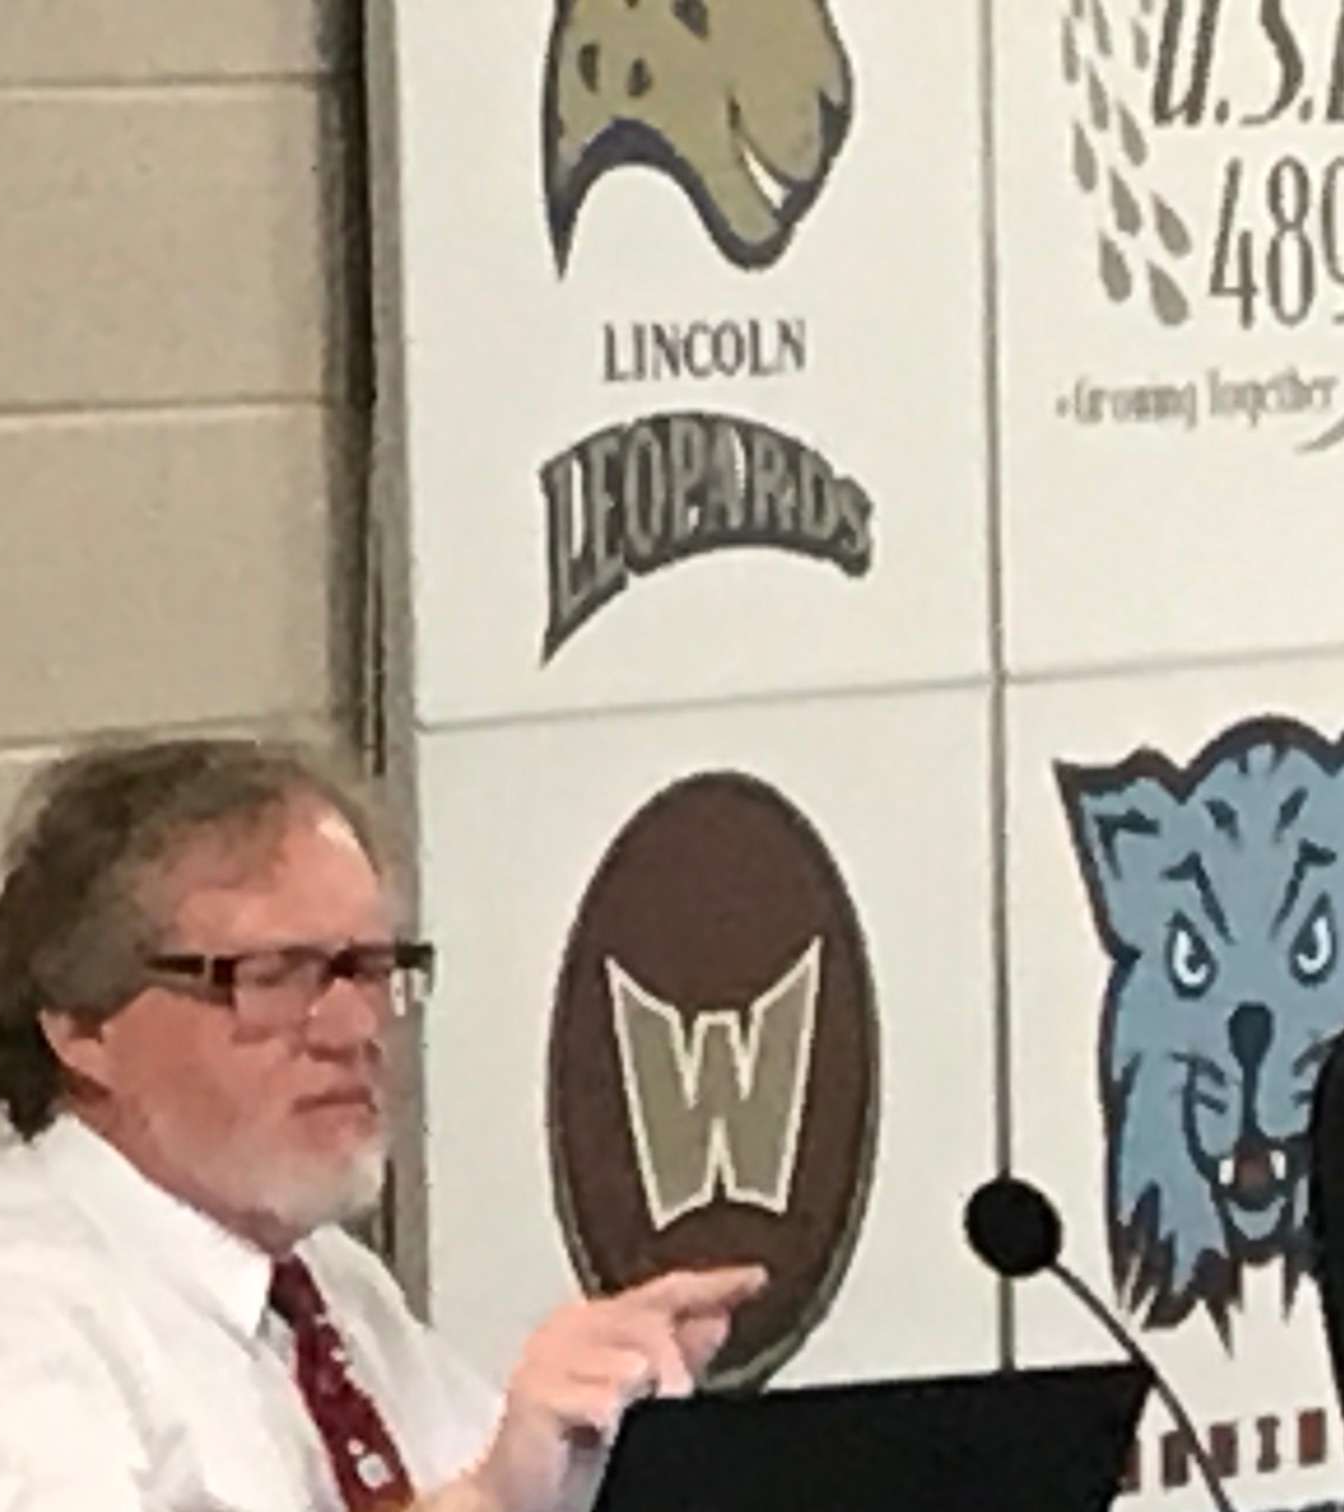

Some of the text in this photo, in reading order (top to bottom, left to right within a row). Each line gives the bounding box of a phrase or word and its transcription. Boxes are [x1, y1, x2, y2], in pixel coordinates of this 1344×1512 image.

[603, 318, 808, 382] LINCOLN
[540, 410, 876, 667] LEOPARDS
[604, 935, 824, 1232] W
